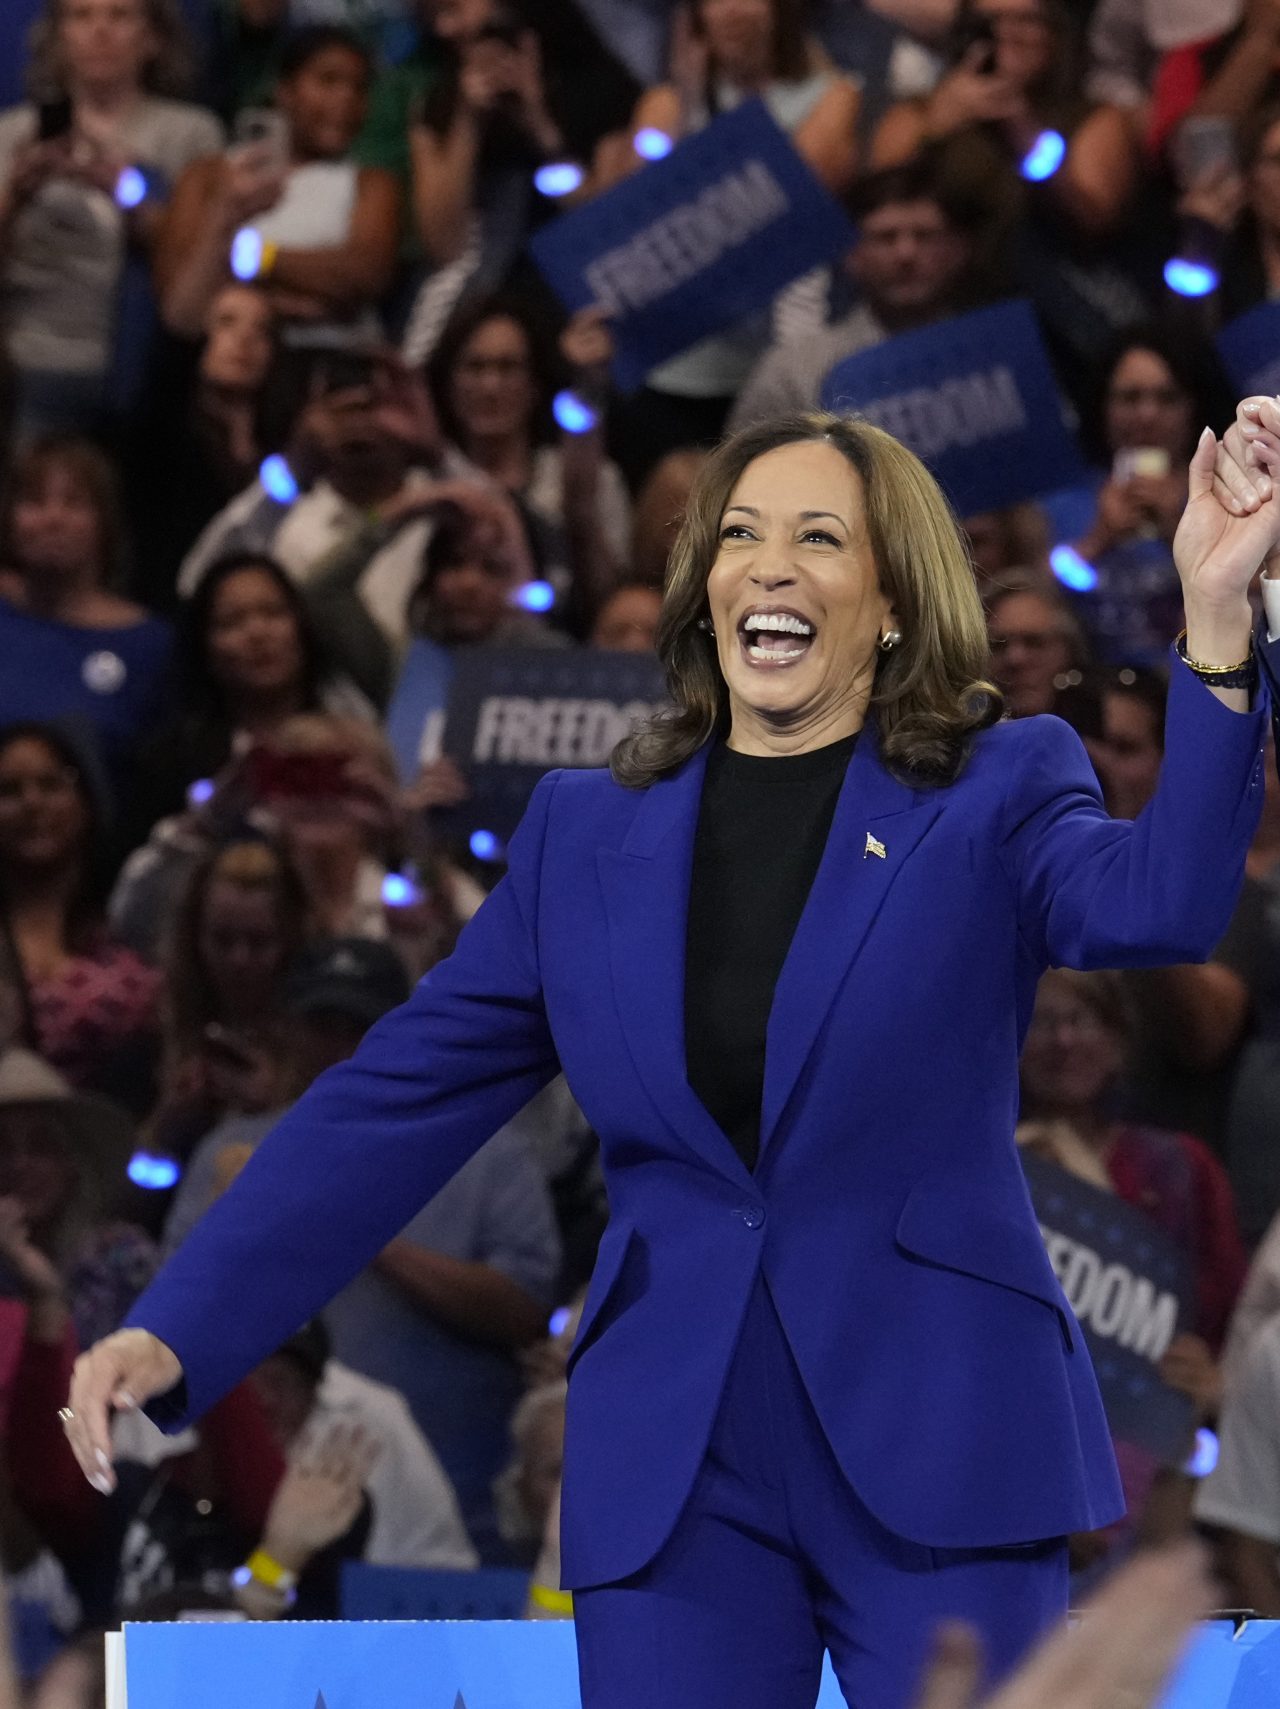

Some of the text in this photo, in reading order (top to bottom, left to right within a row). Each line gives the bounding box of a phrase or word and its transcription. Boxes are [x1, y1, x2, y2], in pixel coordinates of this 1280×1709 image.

[584, 156, 790, 319] FREEDOM
[474, 695, 688, 764] FREED
[1039, 1223, 1178, 1362] EDOM
